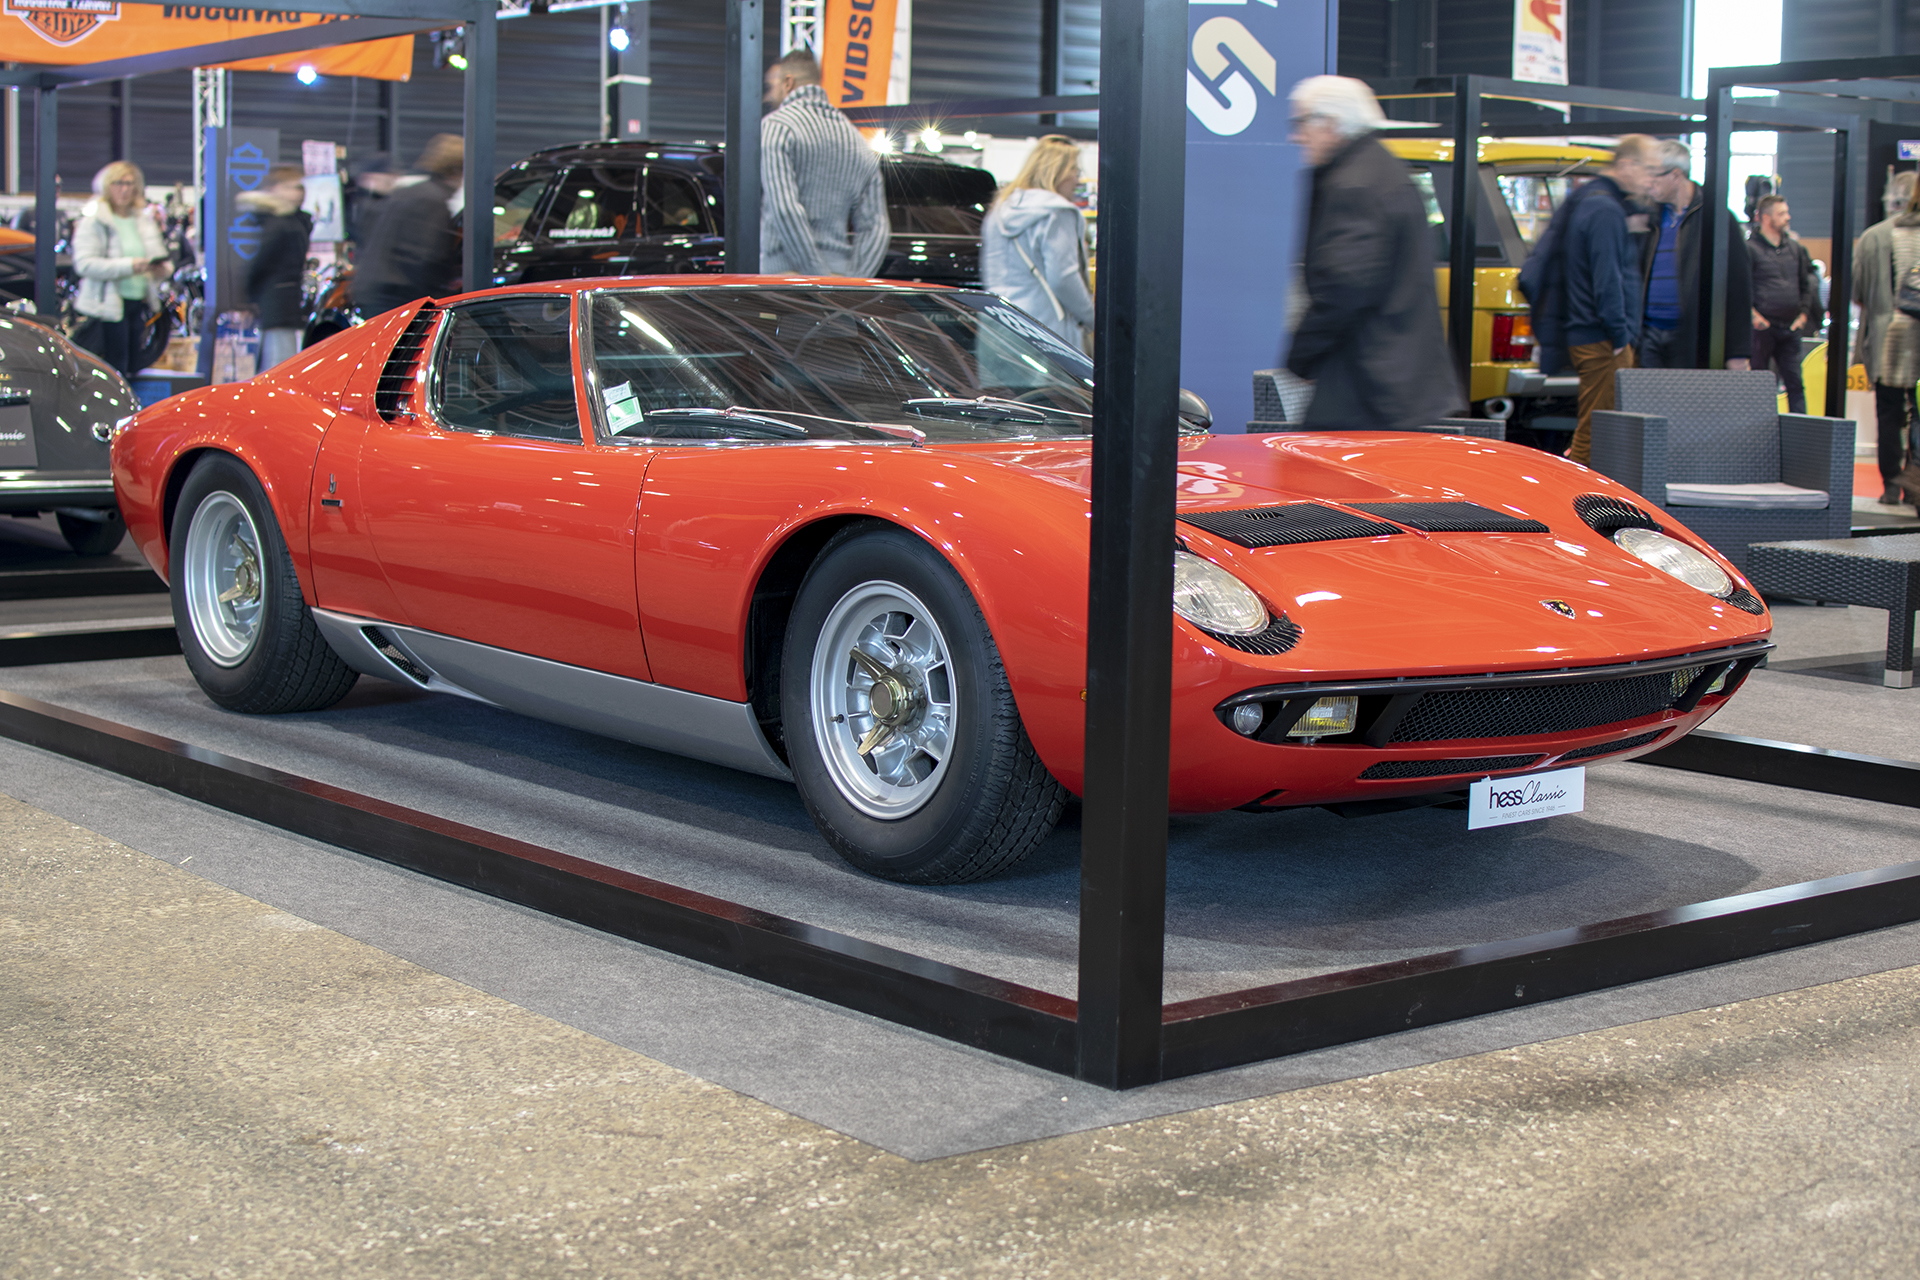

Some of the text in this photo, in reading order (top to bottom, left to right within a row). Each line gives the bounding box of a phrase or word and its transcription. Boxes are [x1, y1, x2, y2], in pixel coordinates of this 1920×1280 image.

[1489, 779, 1566, 809] hessClassic
[1502, 811, 1517, 819] FINEST
[1518, 809, 1530, 817] CARS
[1531, 806, 1545, 815] SINCE
